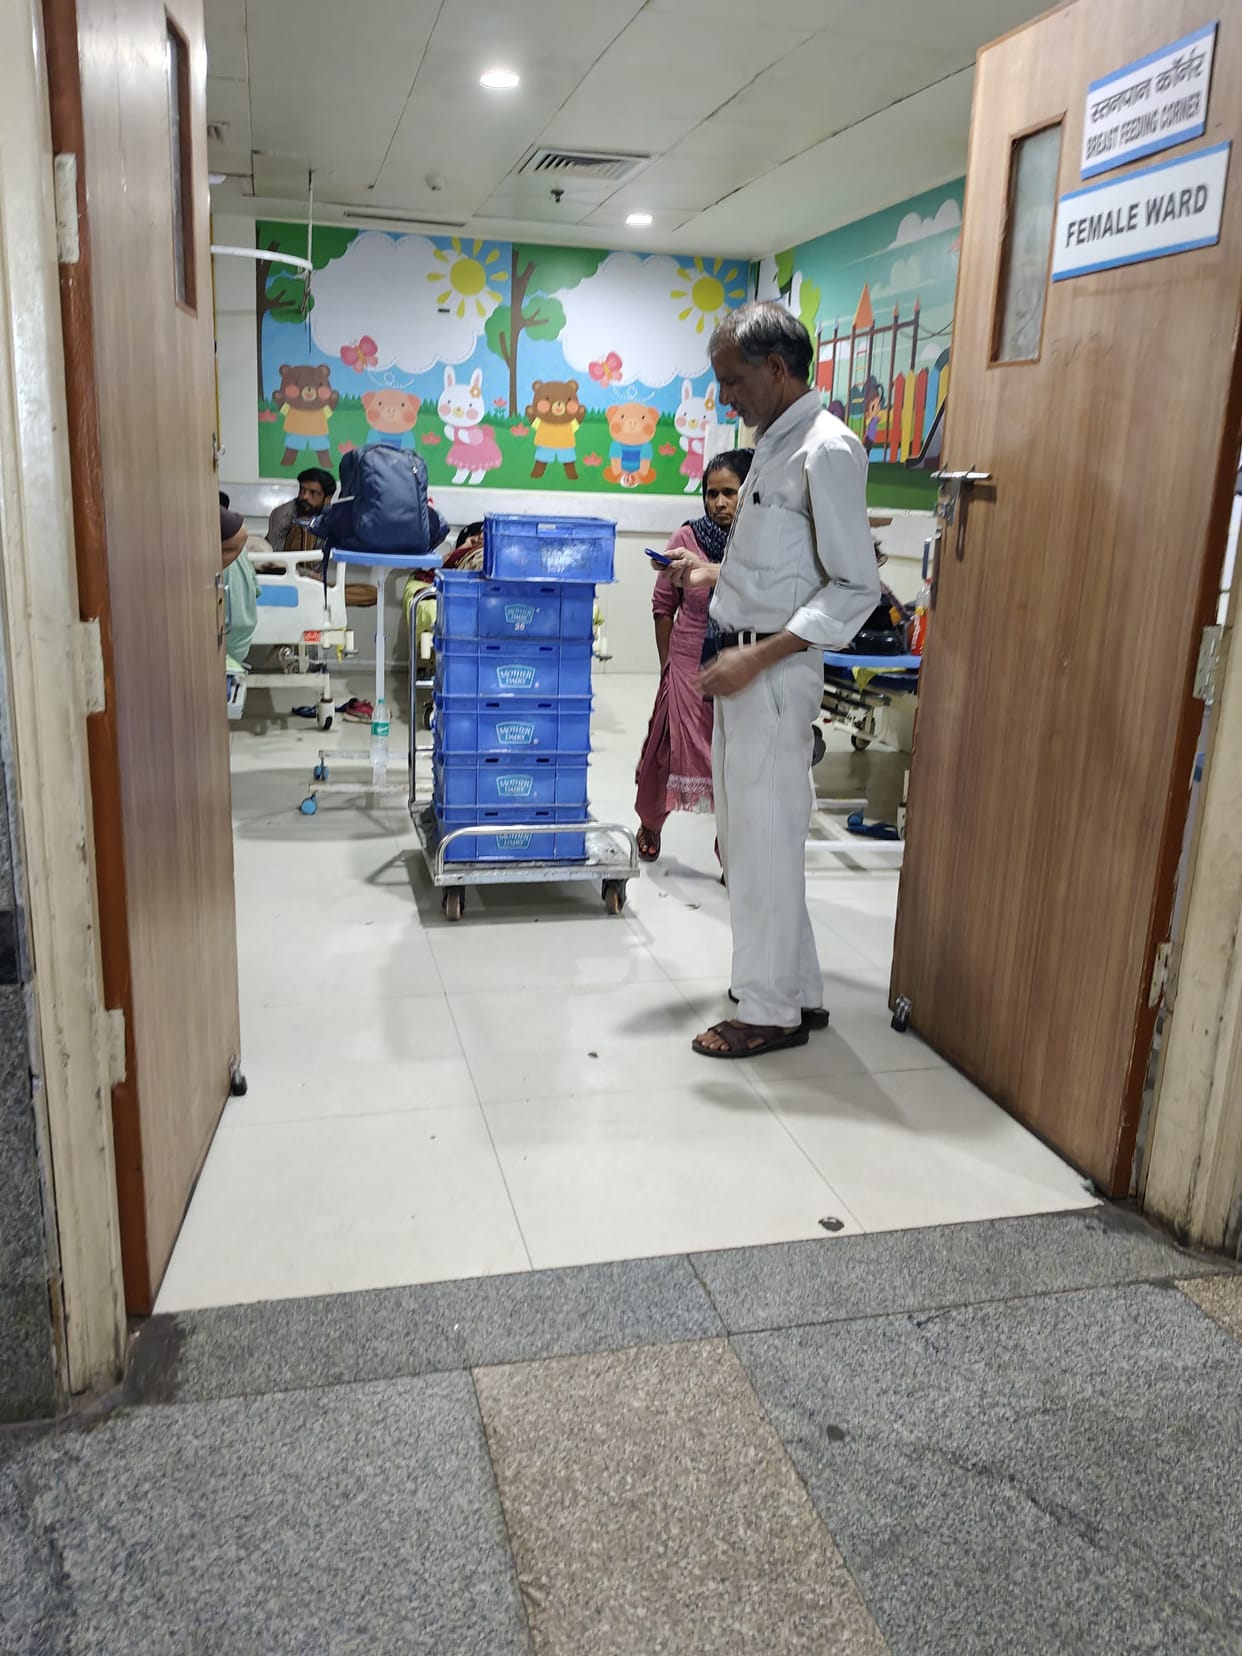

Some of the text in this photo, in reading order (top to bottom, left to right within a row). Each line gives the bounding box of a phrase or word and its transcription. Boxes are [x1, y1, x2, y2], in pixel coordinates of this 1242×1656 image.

[1086, 91, 1202, 160] BREAST FEEDING CORNER
[1065, 184, 1208, 247] FEMALE WARD
